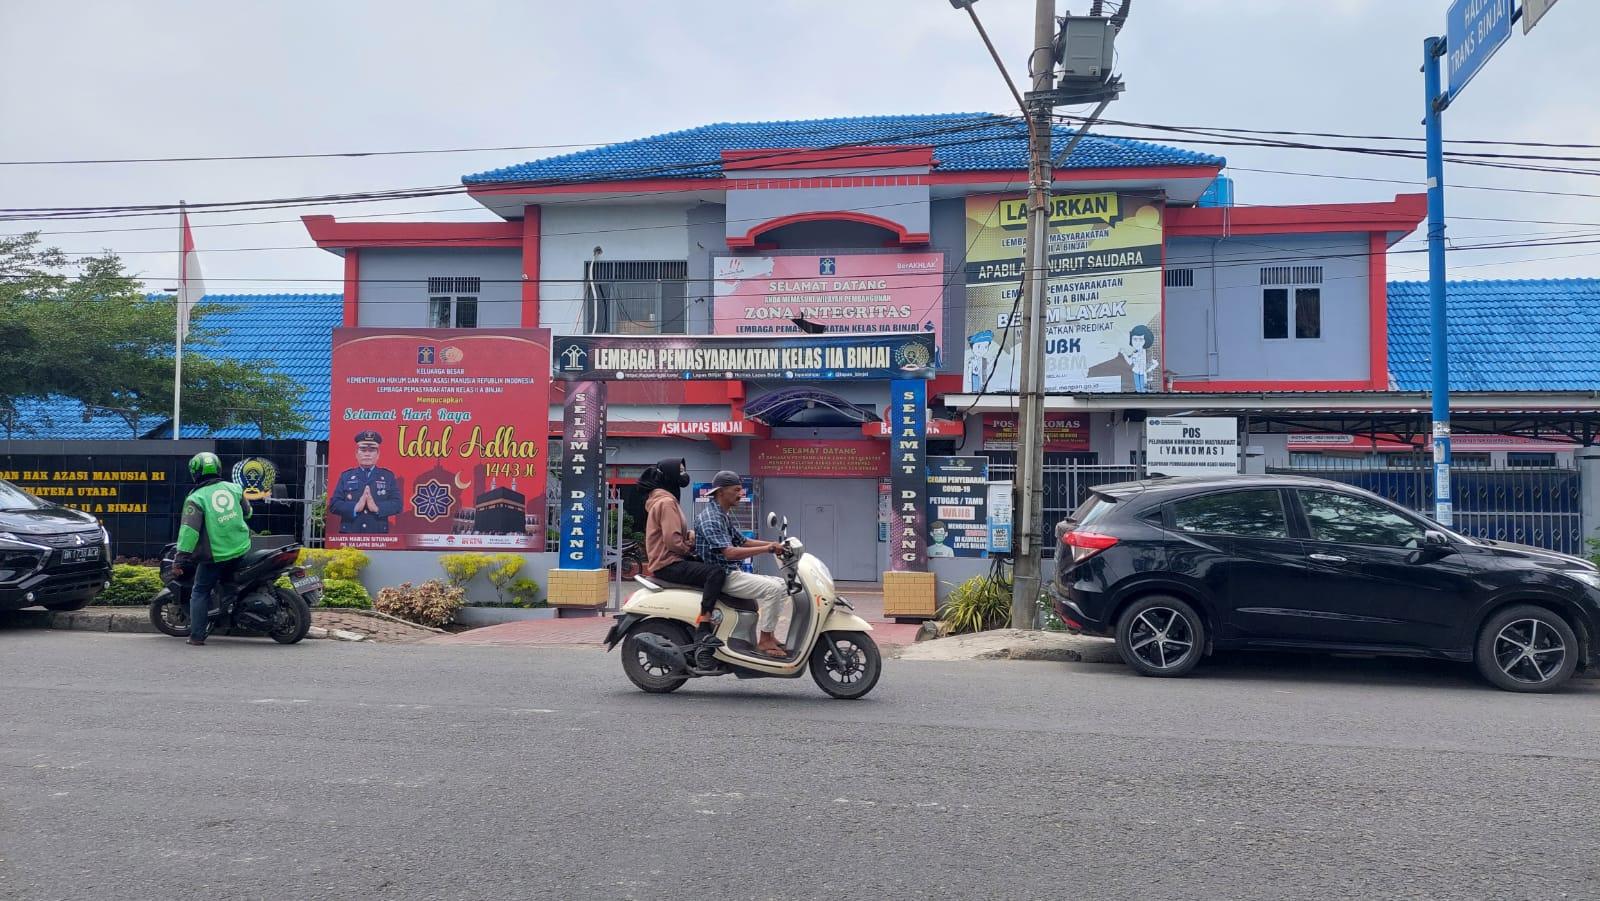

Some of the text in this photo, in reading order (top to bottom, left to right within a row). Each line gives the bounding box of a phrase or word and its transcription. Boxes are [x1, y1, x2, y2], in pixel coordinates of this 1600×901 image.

[1464, 0, 1489, 29] HAL
[1450, 0, 1505, 76] TRANS BINJAI
[1007, 196, 1108, 220] LARKAN
[1063, 241, 1088, 251] BINJAI
[978, 251, 1143, 280] APABILA NURUT SAUDARA
[769, 280, 887, 292] SELAMAT DATANG
[1062, 295, 1068, 303] A
[1071, 291, 1099, 303] BINJAI
[744, 305, 912, 319] ZONA INTEGRITAS
[1065, 301, 1127, 321] LAYAK
[736, 325, 774, 333] LEMBAGA
[852, 324, 878, 332] KELAS
[879, 324, 893, 332] IIA
[894, 323, 920, 332] BINJAI
[1076, 321, 1114, 333] PREDIKAT
[594, 346, 891, 370] LEMBAGA PEMASYARAKATAN KELAS IIA BINJAI
[343, 407, 471, 424] Selamat Hari Raya
[661, 421, 743, 434] ASN LAPAS BINJAI
[993, 420, 1014, 428] POS
[1182, 427, 1201, 438] POS
[398, 425, 539, 458] Idul Adha
[23, 471, 48, 480] HAK
[53, 471, 88, 480] AZASI
[93, 471, 147, 480] MANUSIA
[152, 471, 165, 480] RI
[486, 463, 520, 477] 1443
[900, 391, 919, 562] SELAMAT DATANG
[570, 393, 588, 561] SELAMAT DATANG
[25, 487, 117, 496] MATERA UTARA
[95, 503, 103, 512] A
[107, 503, 147, 512] BINJAI
[965, 497, 983, 505] TAMU
[943, 508, 970, 518] WAJIB
